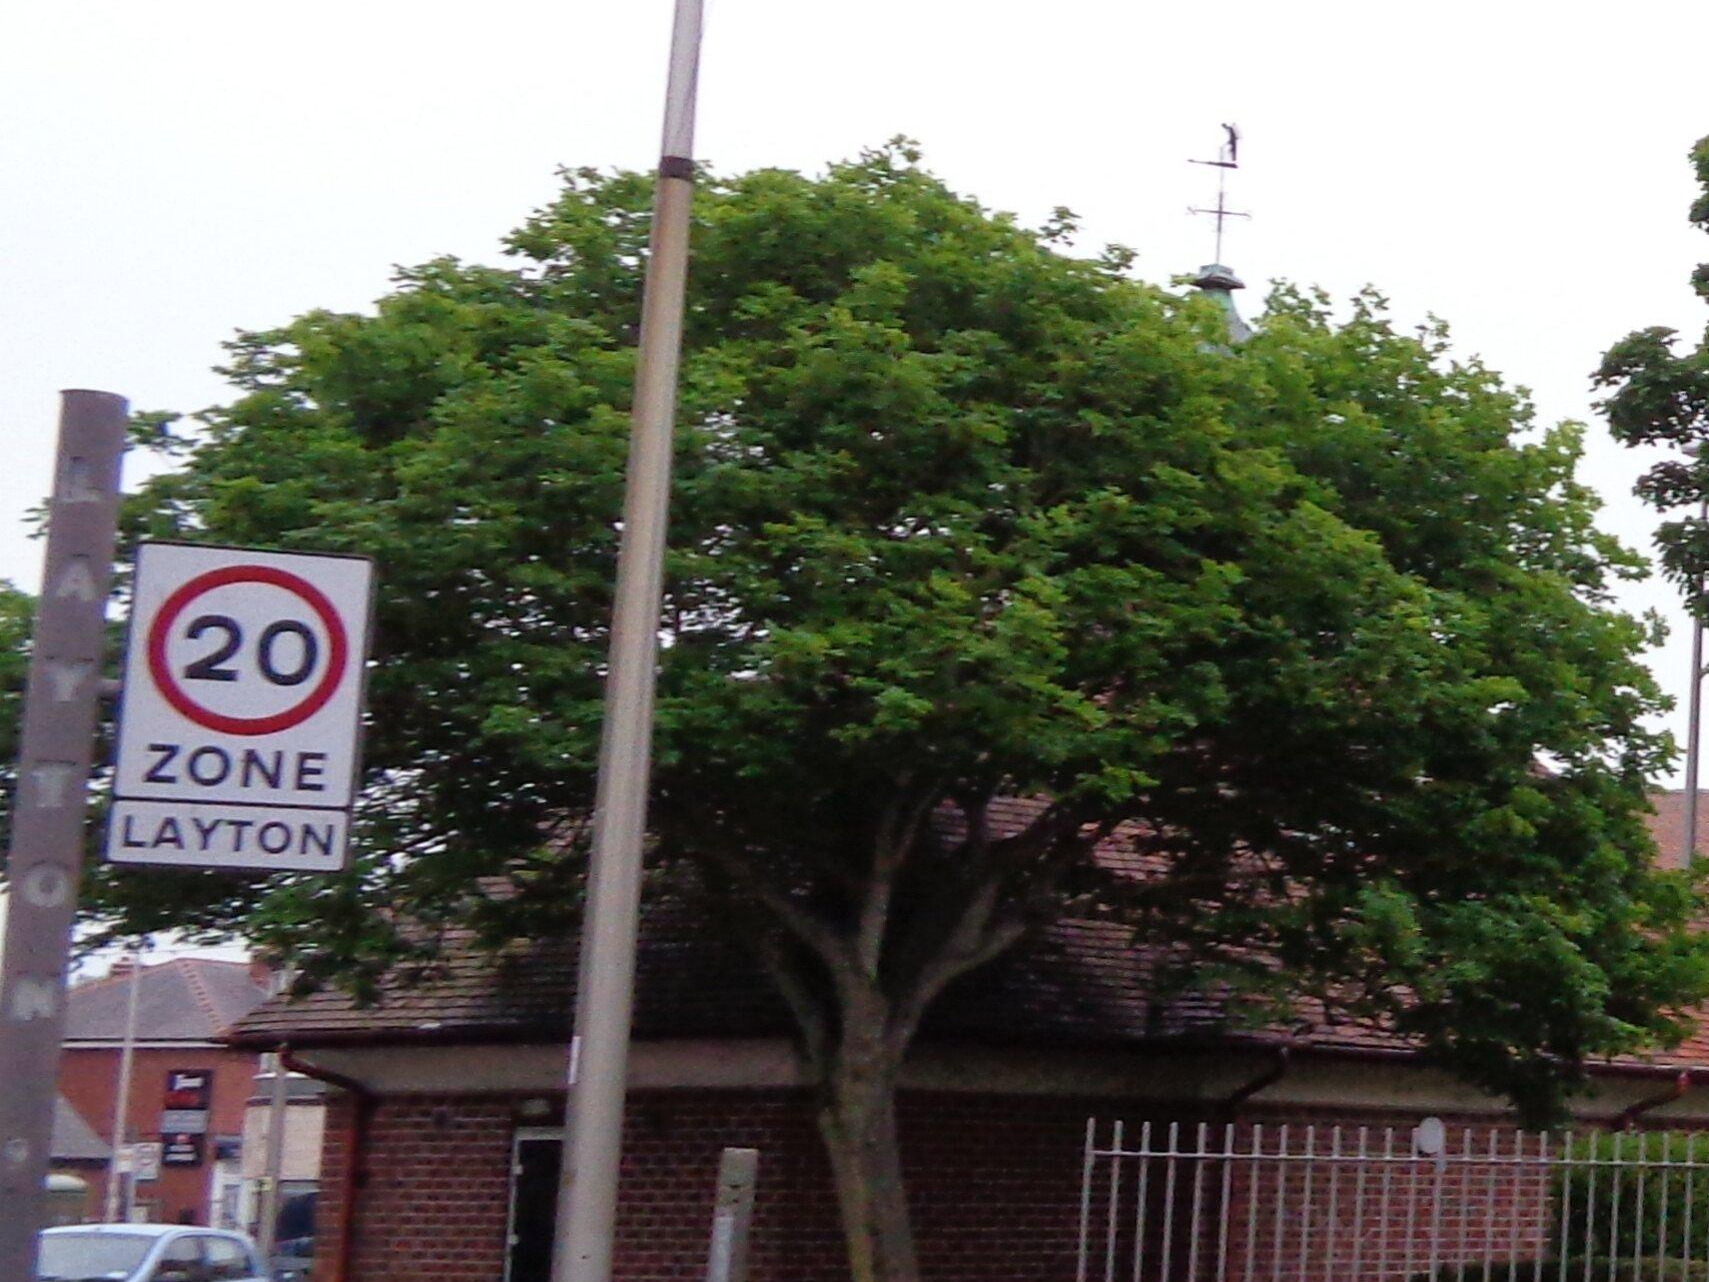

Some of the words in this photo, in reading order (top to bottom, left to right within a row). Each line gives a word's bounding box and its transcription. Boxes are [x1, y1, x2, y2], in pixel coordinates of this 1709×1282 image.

[183, 614, 319, 687] 20
[143, 744, 326, 792] ZONE
[121, 816, 335, 857] LAYTON
